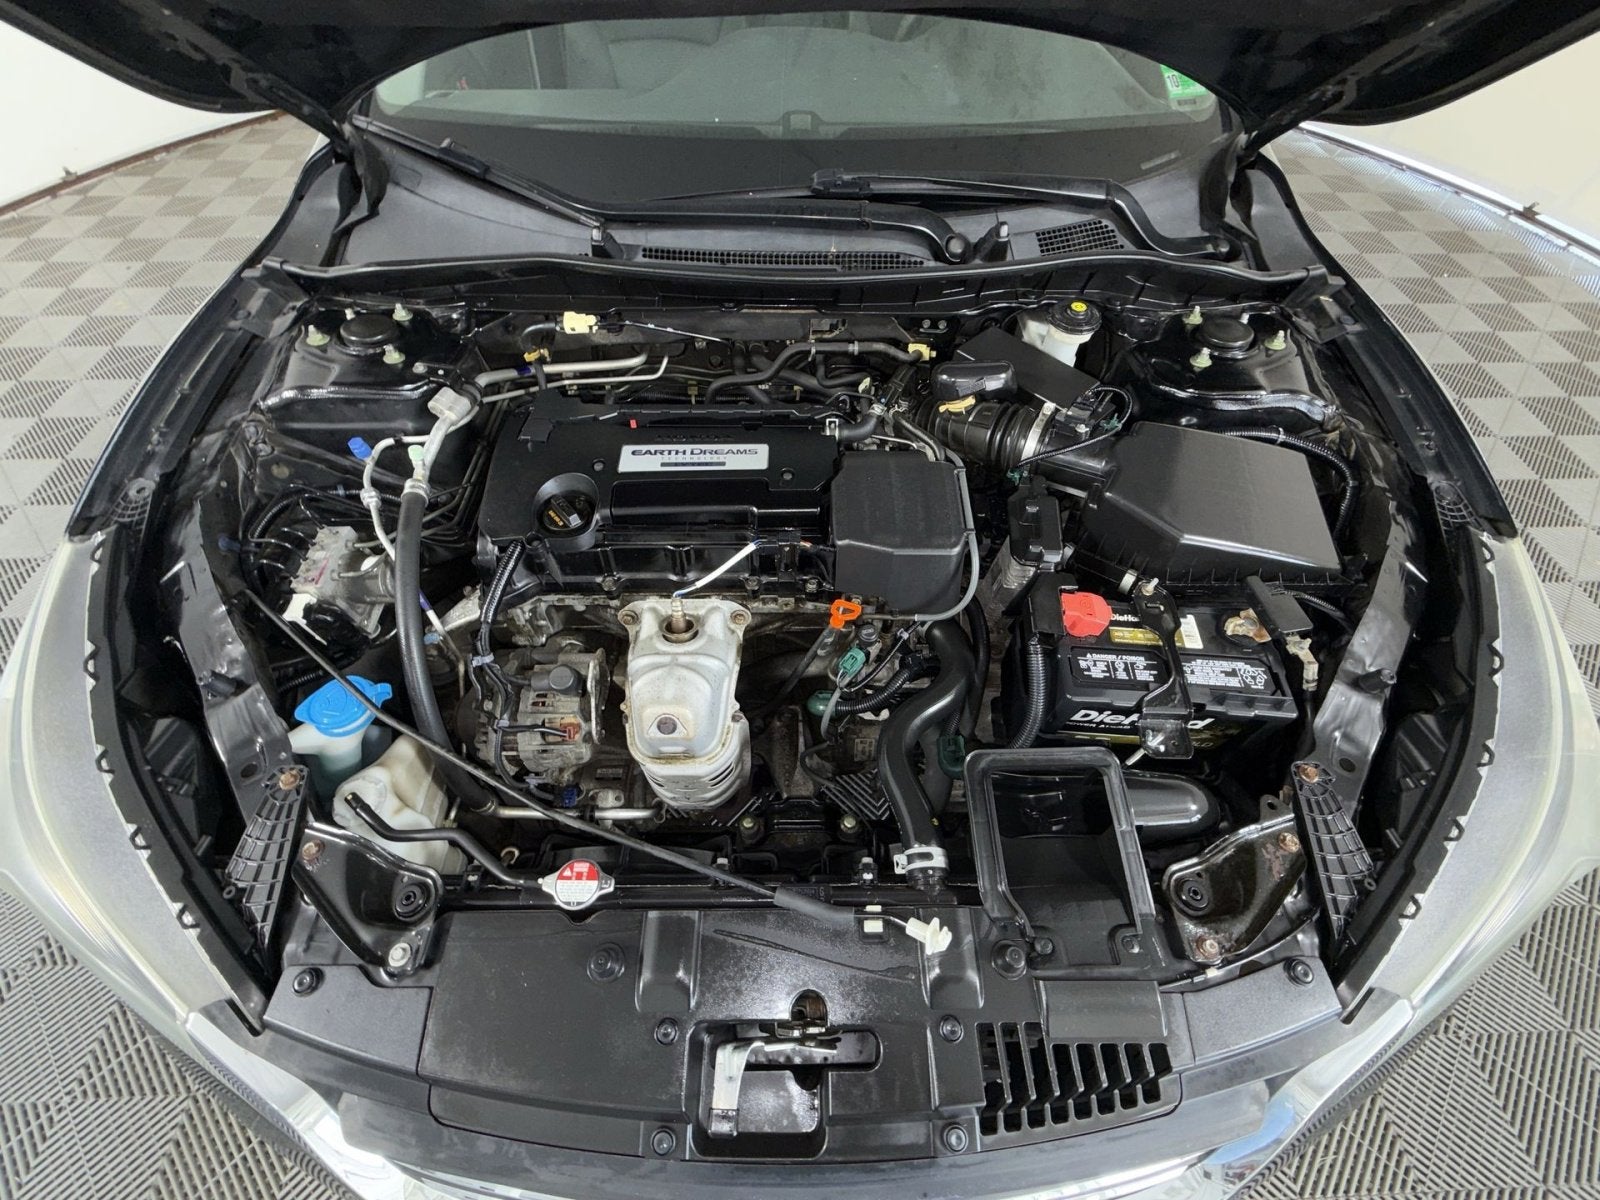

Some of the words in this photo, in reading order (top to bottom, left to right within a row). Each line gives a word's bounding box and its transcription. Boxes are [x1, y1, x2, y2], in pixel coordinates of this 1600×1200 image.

[1166, 74, 1180, 88] 10
[630, 448, 687, 456] EARTH
[689, 447, 759, 456] DREAMS
